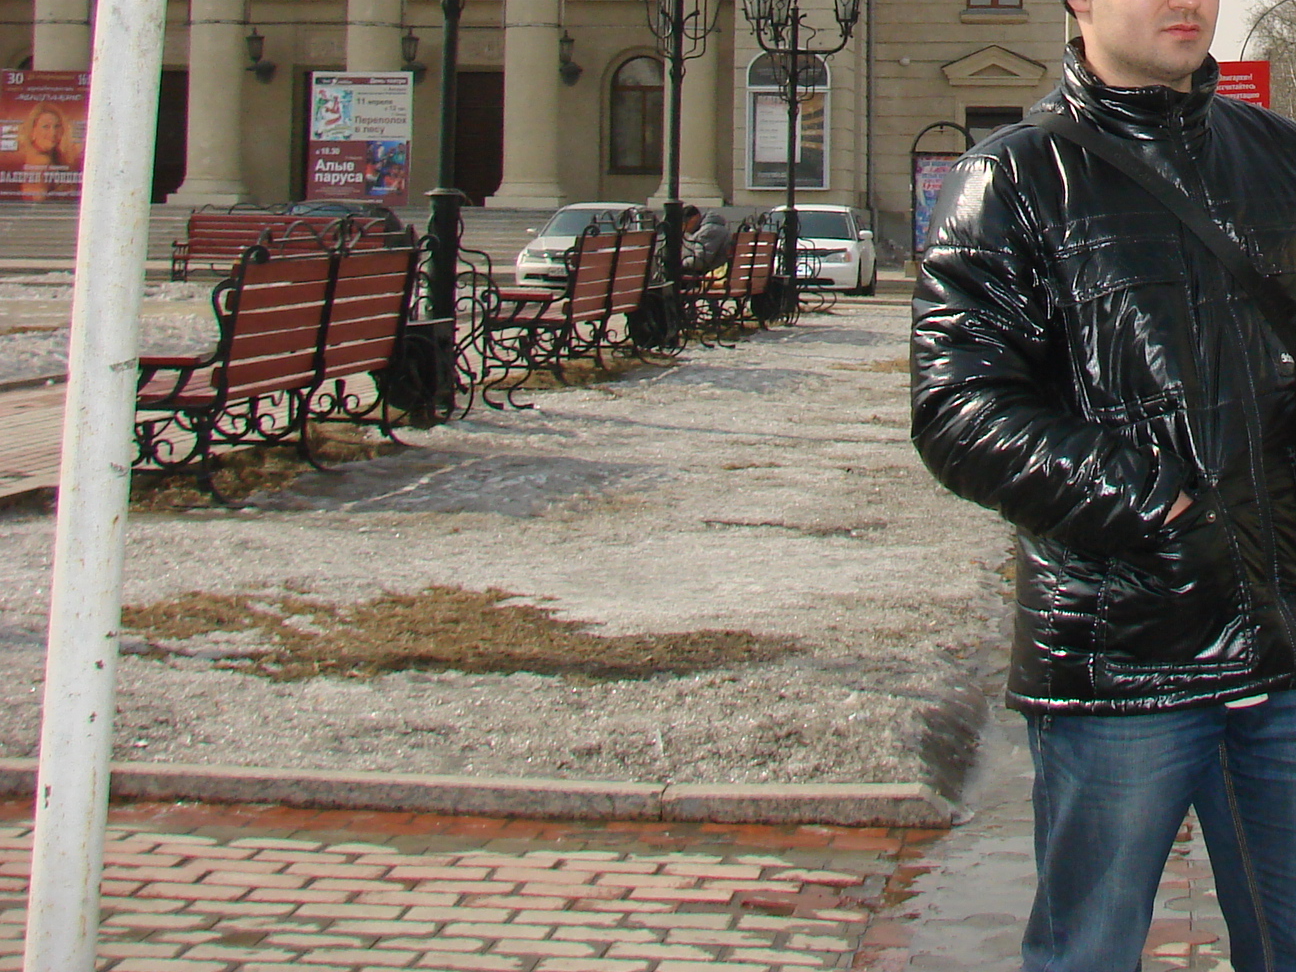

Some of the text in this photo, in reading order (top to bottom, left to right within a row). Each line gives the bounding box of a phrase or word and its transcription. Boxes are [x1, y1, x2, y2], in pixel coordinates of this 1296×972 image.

[7, 72, 24, 85] 30
[354, 116, 407, 125] Переполох
[314, 158, 355, 172] Алые
[314, 172, 364, 186] паруса
